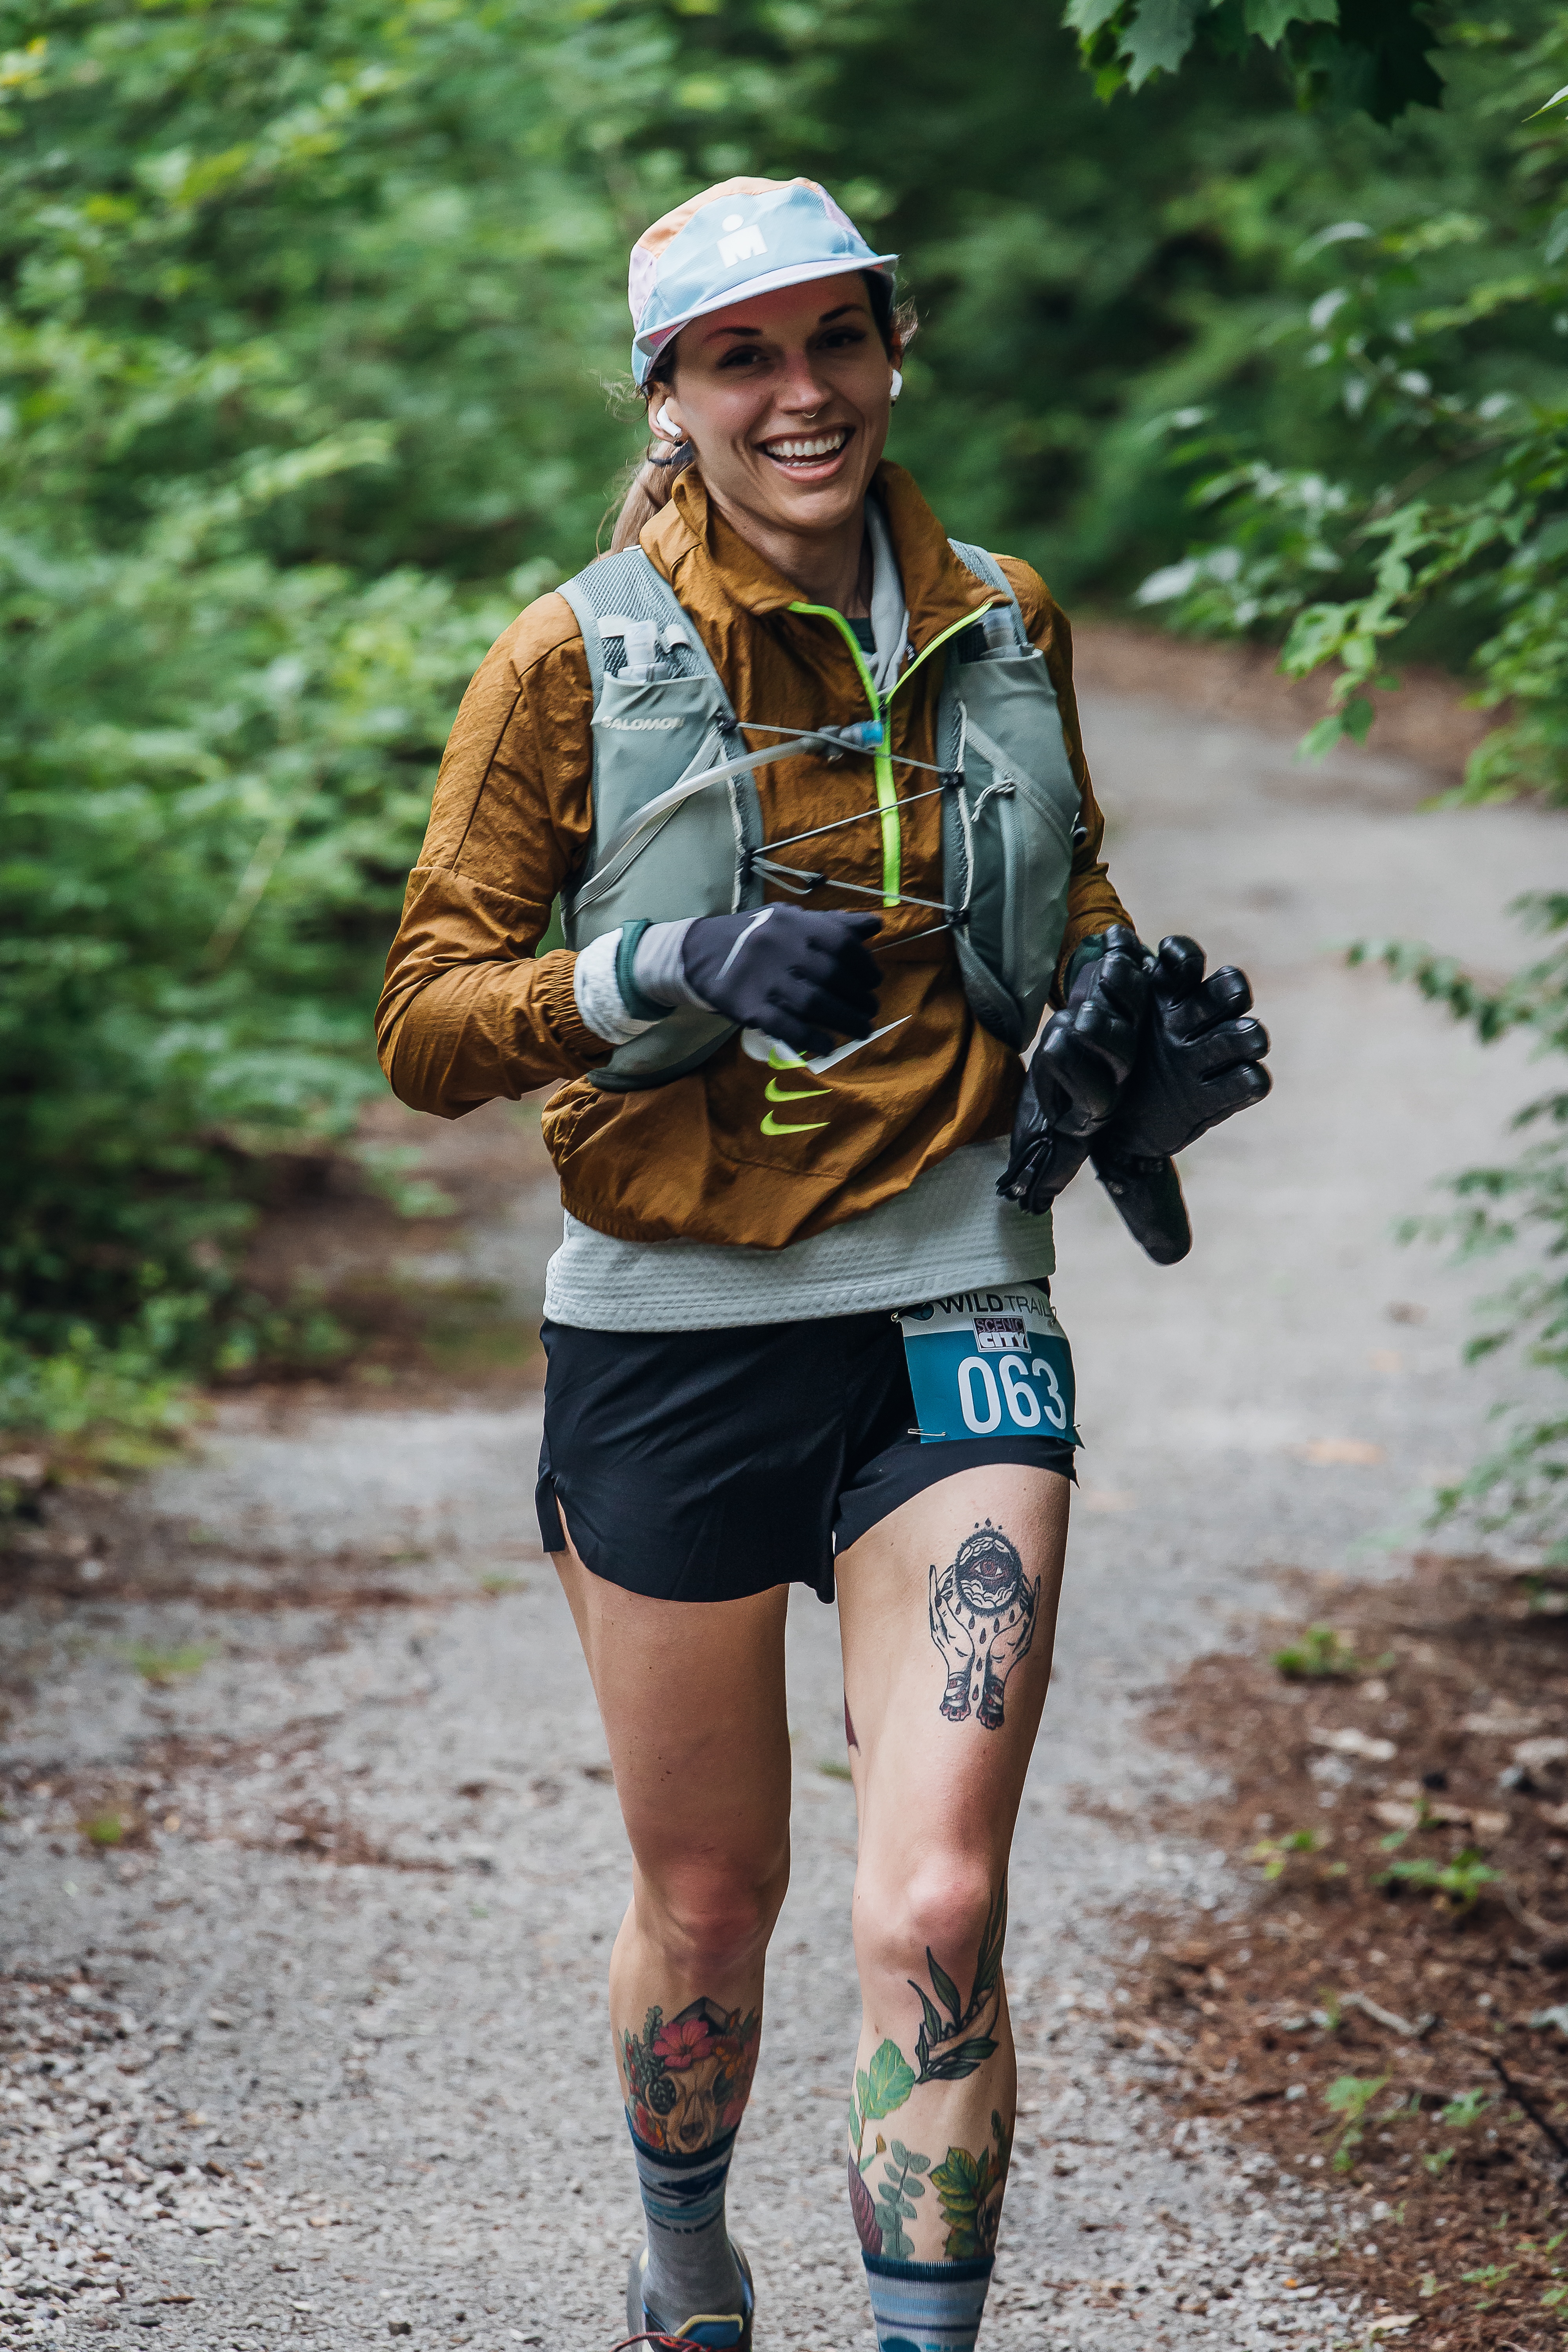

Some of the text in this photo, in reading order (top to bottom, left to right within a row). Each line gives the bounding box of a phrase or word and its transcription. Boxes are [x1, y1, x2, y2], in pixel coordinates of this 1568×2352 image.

[936, 1293, 1004, 1314] WILD
[976, 1318, 1024, 1333] SCENIC
[978, 1333, 1025, 1348] CITY
[957, 1354, 1066, 1434] 063
